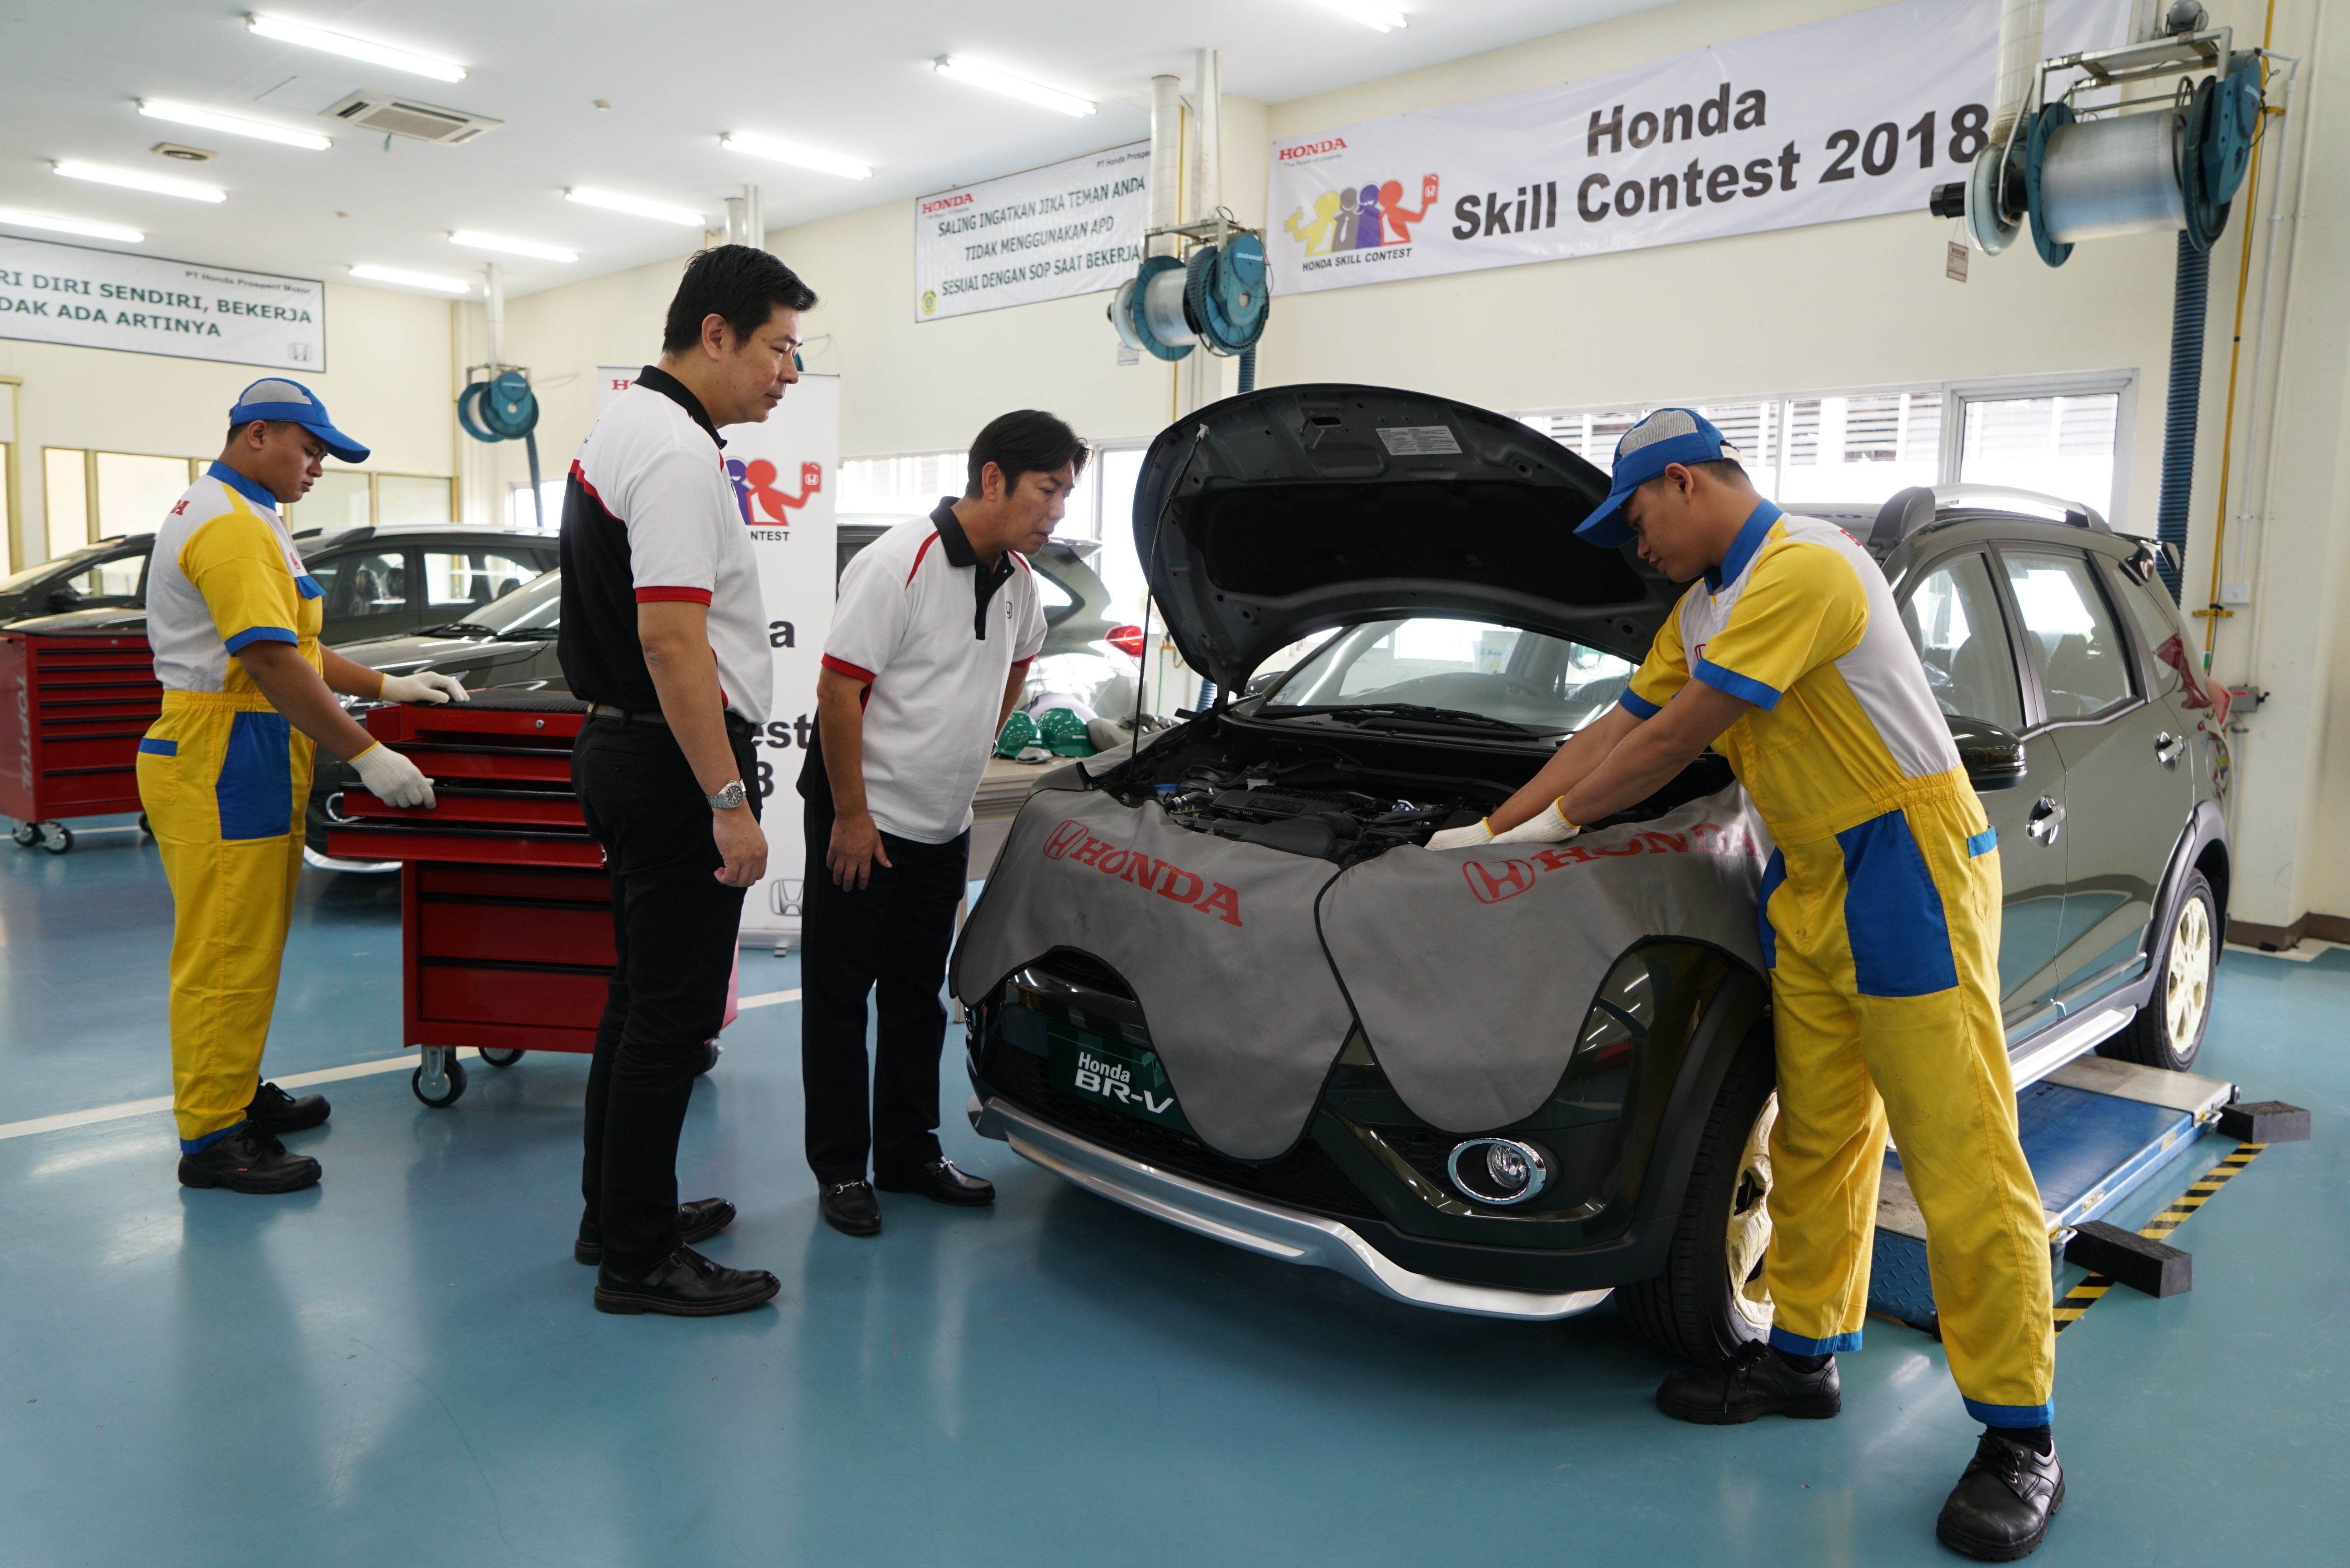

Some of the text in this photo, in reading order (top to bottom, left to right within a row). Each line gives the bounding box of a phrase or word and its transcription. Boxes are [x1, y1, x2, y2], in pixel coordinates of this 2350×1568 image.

[1587, 81, 1766, 156] Honda
[1279, 137, 1347, 160] HONDA
[1452, 104, 1990, 240] Skill Contest 2018
[922, 193, 974, 214] HONDA
[939, 215, 976, 236] SALING
[980, 203, 1035, 228] INGATKAN
[1039, 195, 1065, 214] JIKA
[1068, 183, 1109, 208] TEMAN
[1112, 176, 1145, 199] ANDA
[965, 216, 1115, 261] TIDAK MENGGUNAKAN APD
[1302, 248, 1412, 272] HONDA SKILL CONTEST
[186, 271, 198, 279] PT
[942, 244, 1140, 296] SESUAI DENGAN SOP SAAT BEKERJA
[32, 275, 91, 295] DIRI
[100, 284, 208, 313] SENDIRI,
[217, 299, 312, 323] BEKERJA
[58, 305, 108, 323] ADA
[116, 312, 221, 337] ARTINYA
[1531, 823, 1761, 872] HONDA
[1070, 835, 1243, 928] HONDA
[1078, 1051, 1130, 1083] Honda
[1075, 1069, 1175, 1114] BR-V
